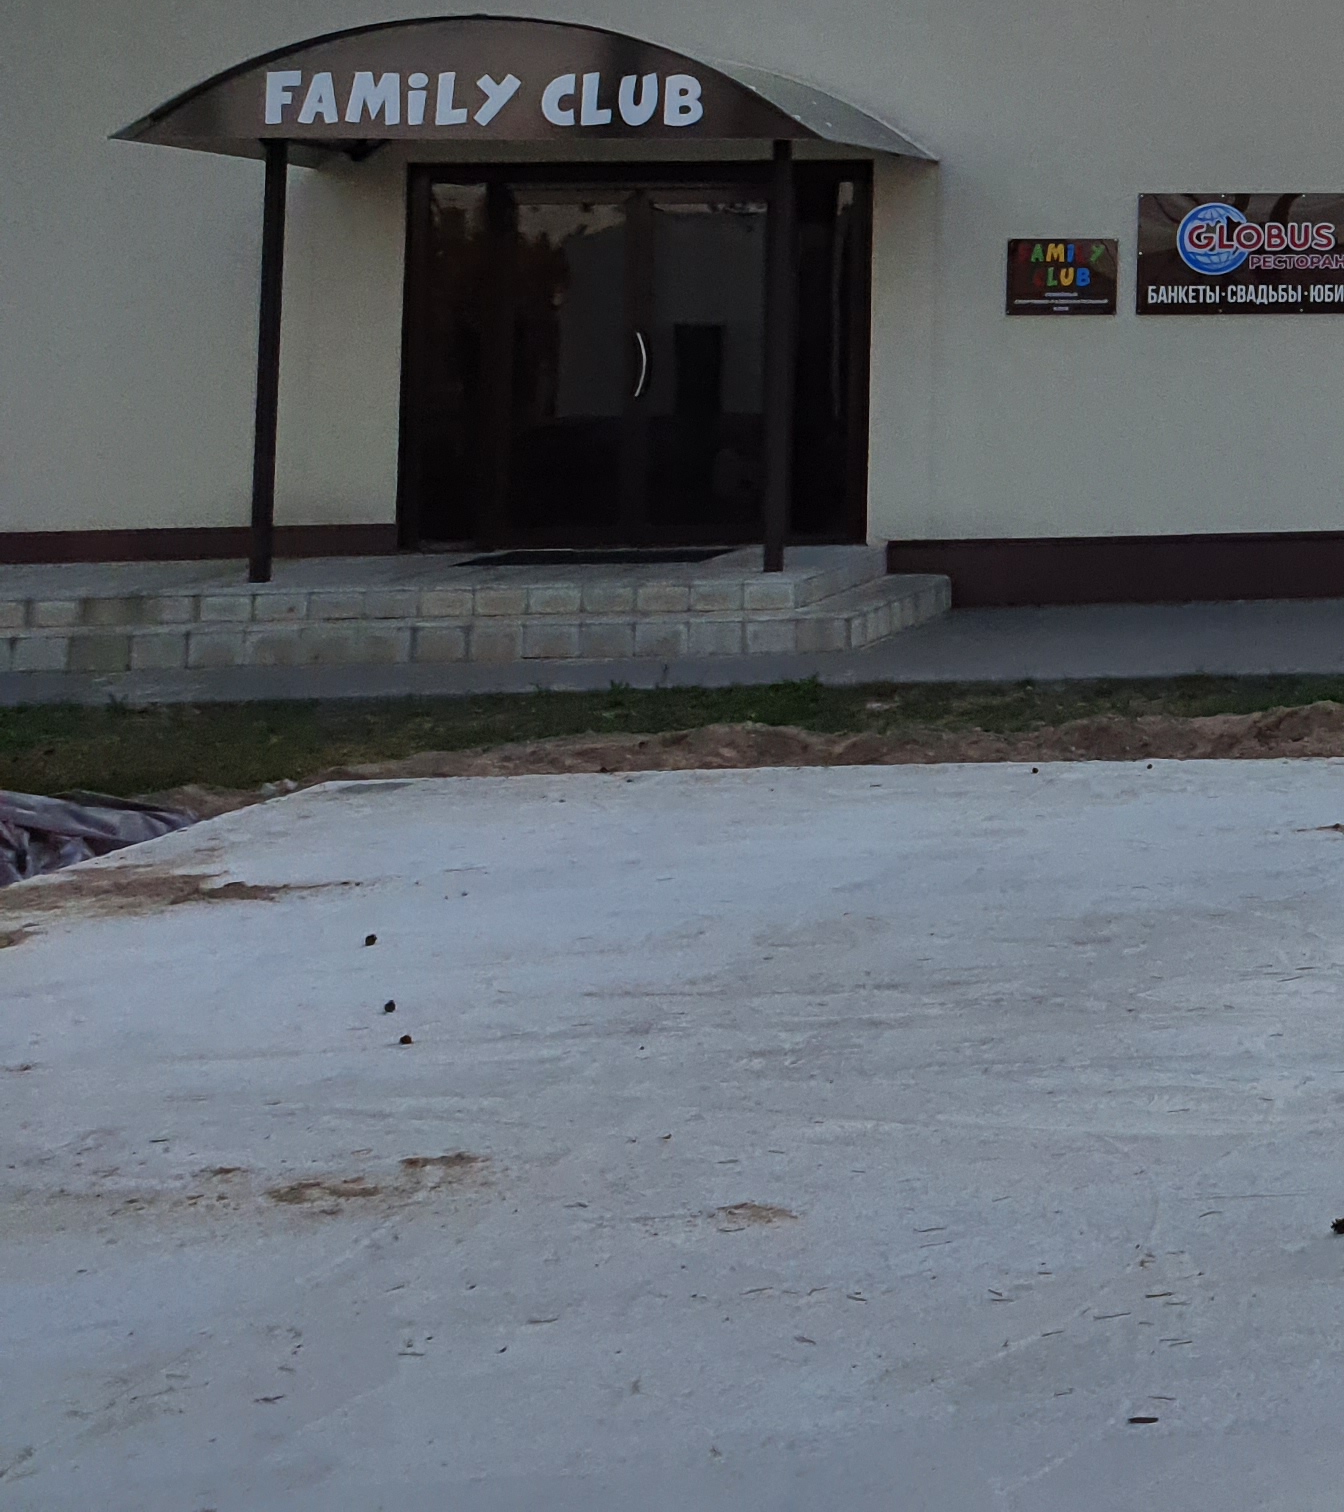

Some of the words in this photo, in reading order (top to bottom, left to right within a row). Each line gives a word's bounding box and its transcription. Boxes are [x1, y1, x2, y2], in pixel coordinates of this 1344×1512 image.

[541, 73, 704, 128] CLUB
[1187, 222, 1336, 251] GLOBUS
[1147, 285, 1220, 304] БАНКЕТЫ
[1227, 284, 1302, 305] СВАДЬБЫ
